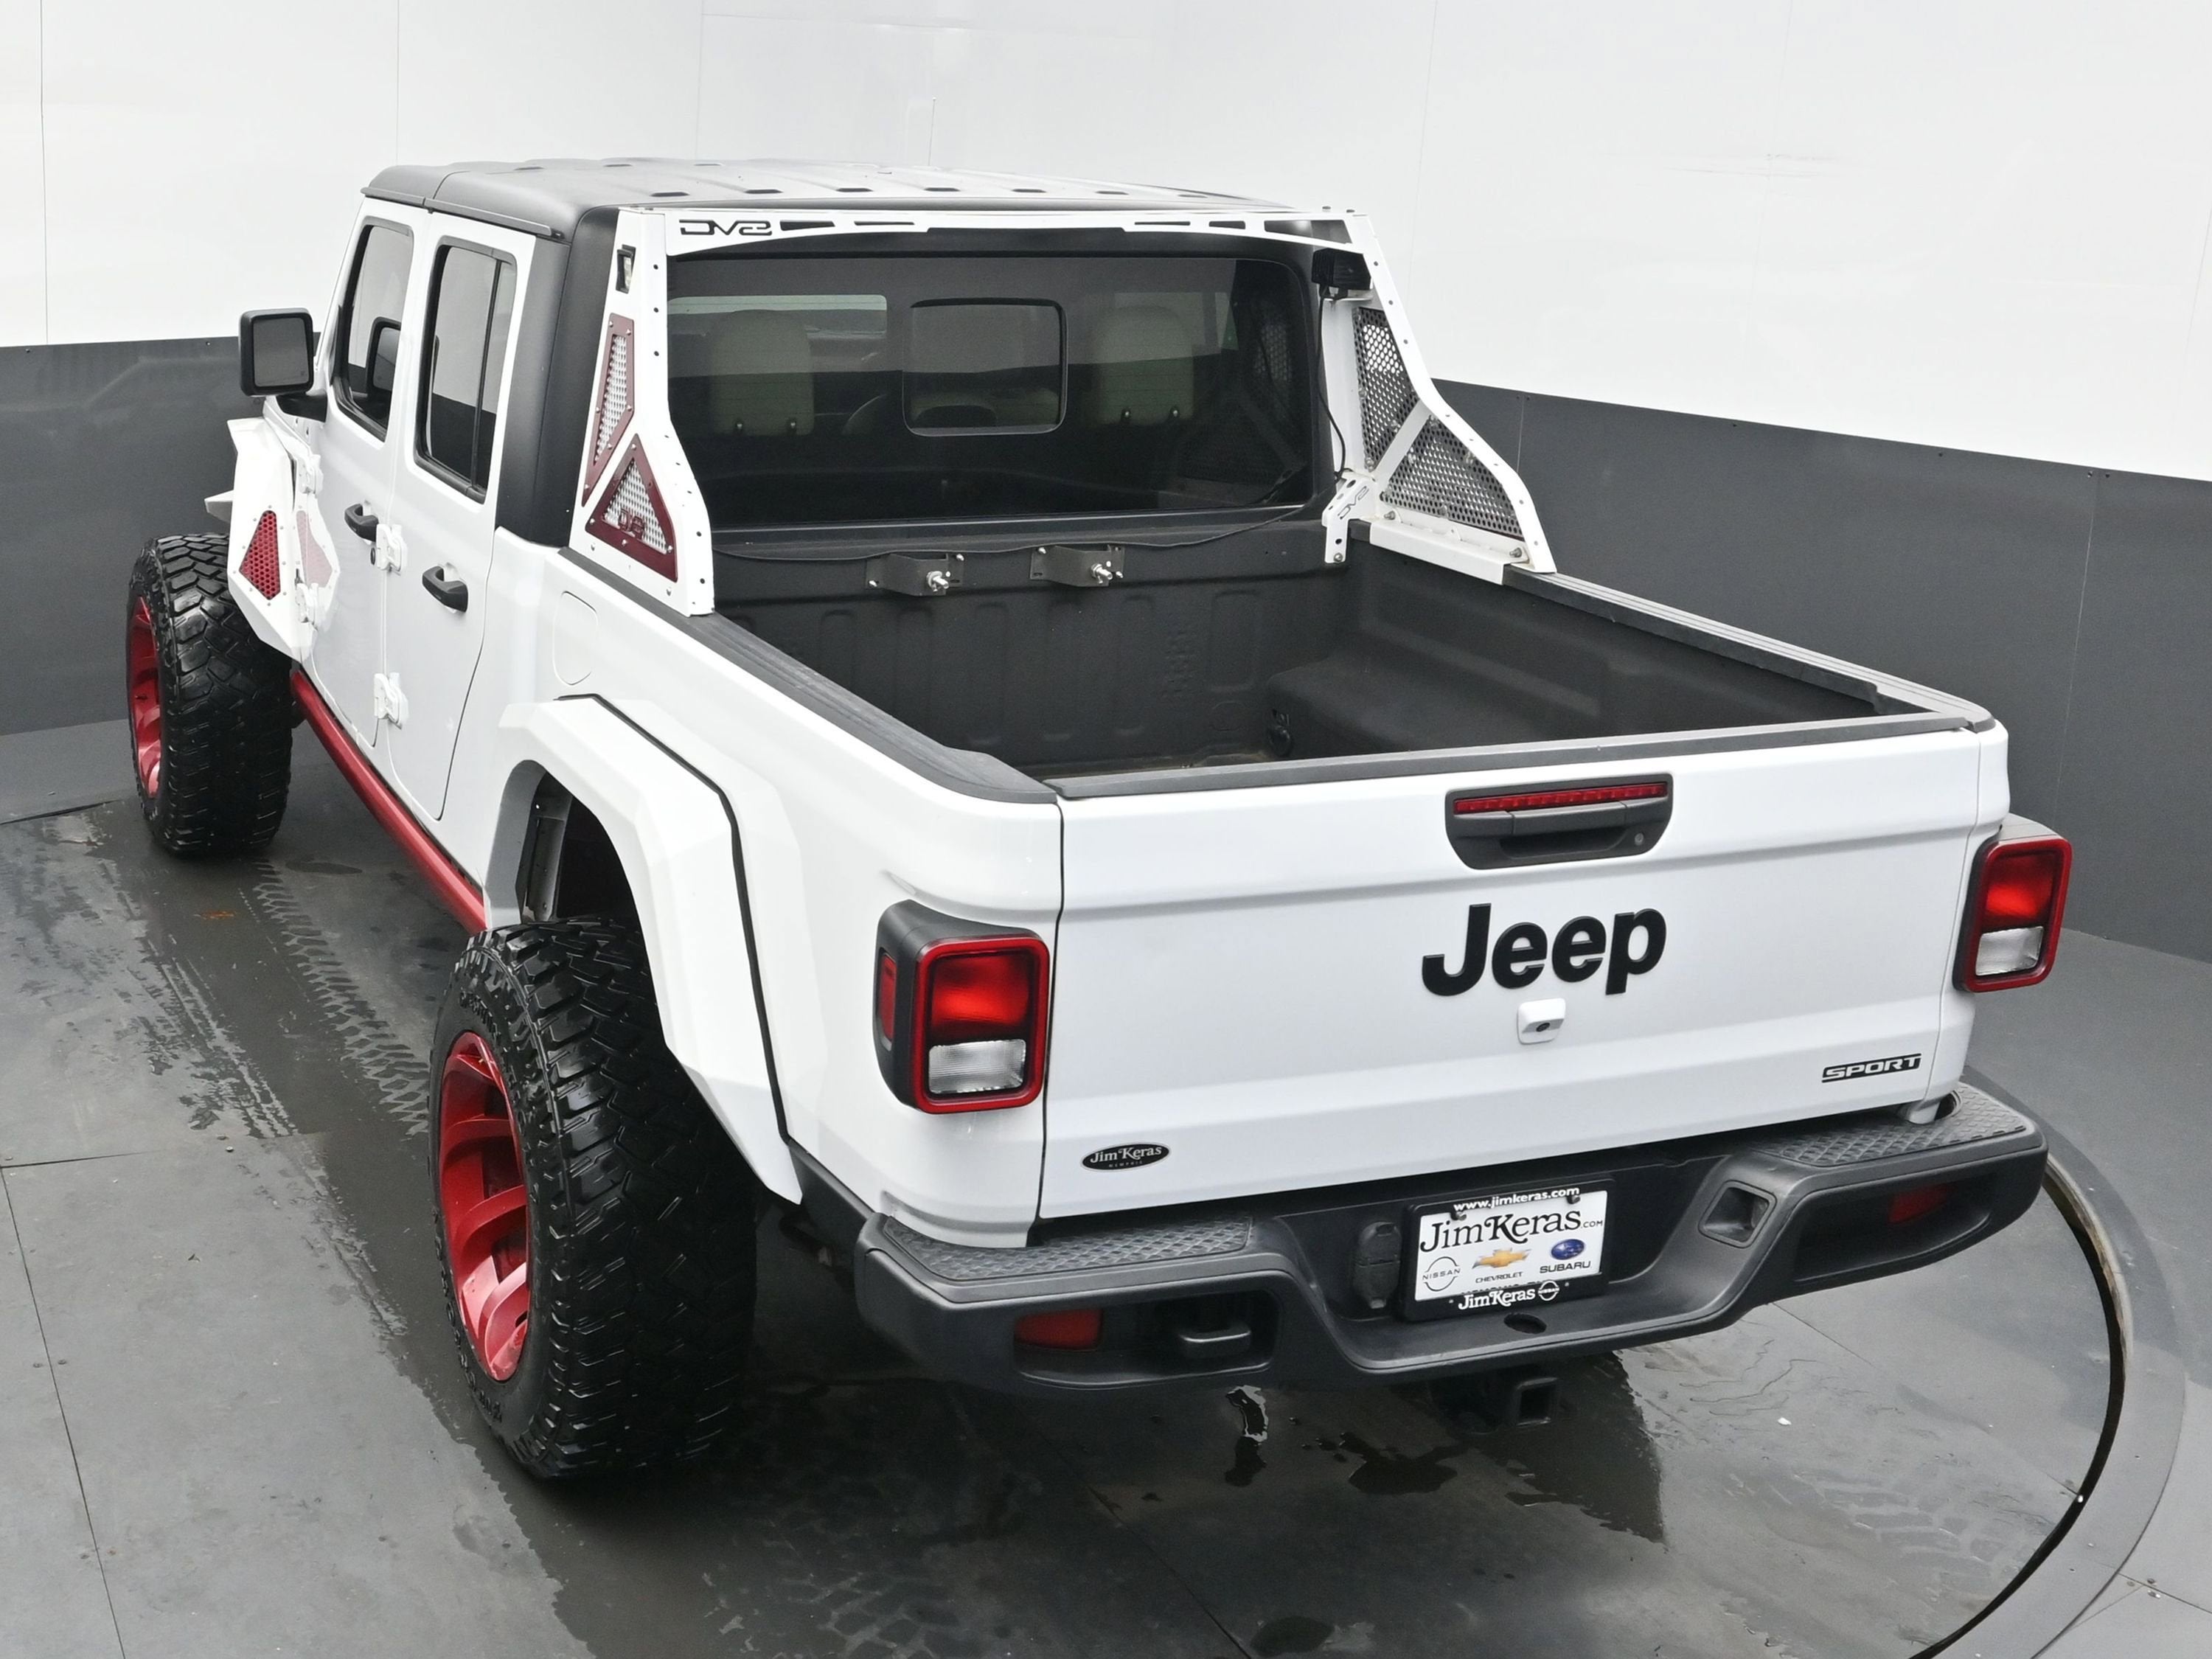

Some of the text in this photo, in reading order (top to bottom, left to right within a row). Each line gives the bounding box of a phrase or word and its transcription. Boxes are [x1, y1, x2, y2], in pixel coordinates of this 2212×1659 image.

[1422, 902, 1666, 996] Jeep
[1826, 1057, 1921, 1078] SPORT
[1453, 1187, 1580, 1211] www.jimkeras.com
[1422, 1268, 1461, 1280] NISSAN
[1540, 1261, 1591, 1273] SUBARU
[1475, 1272, 1523, 1284] CHEVROLET
